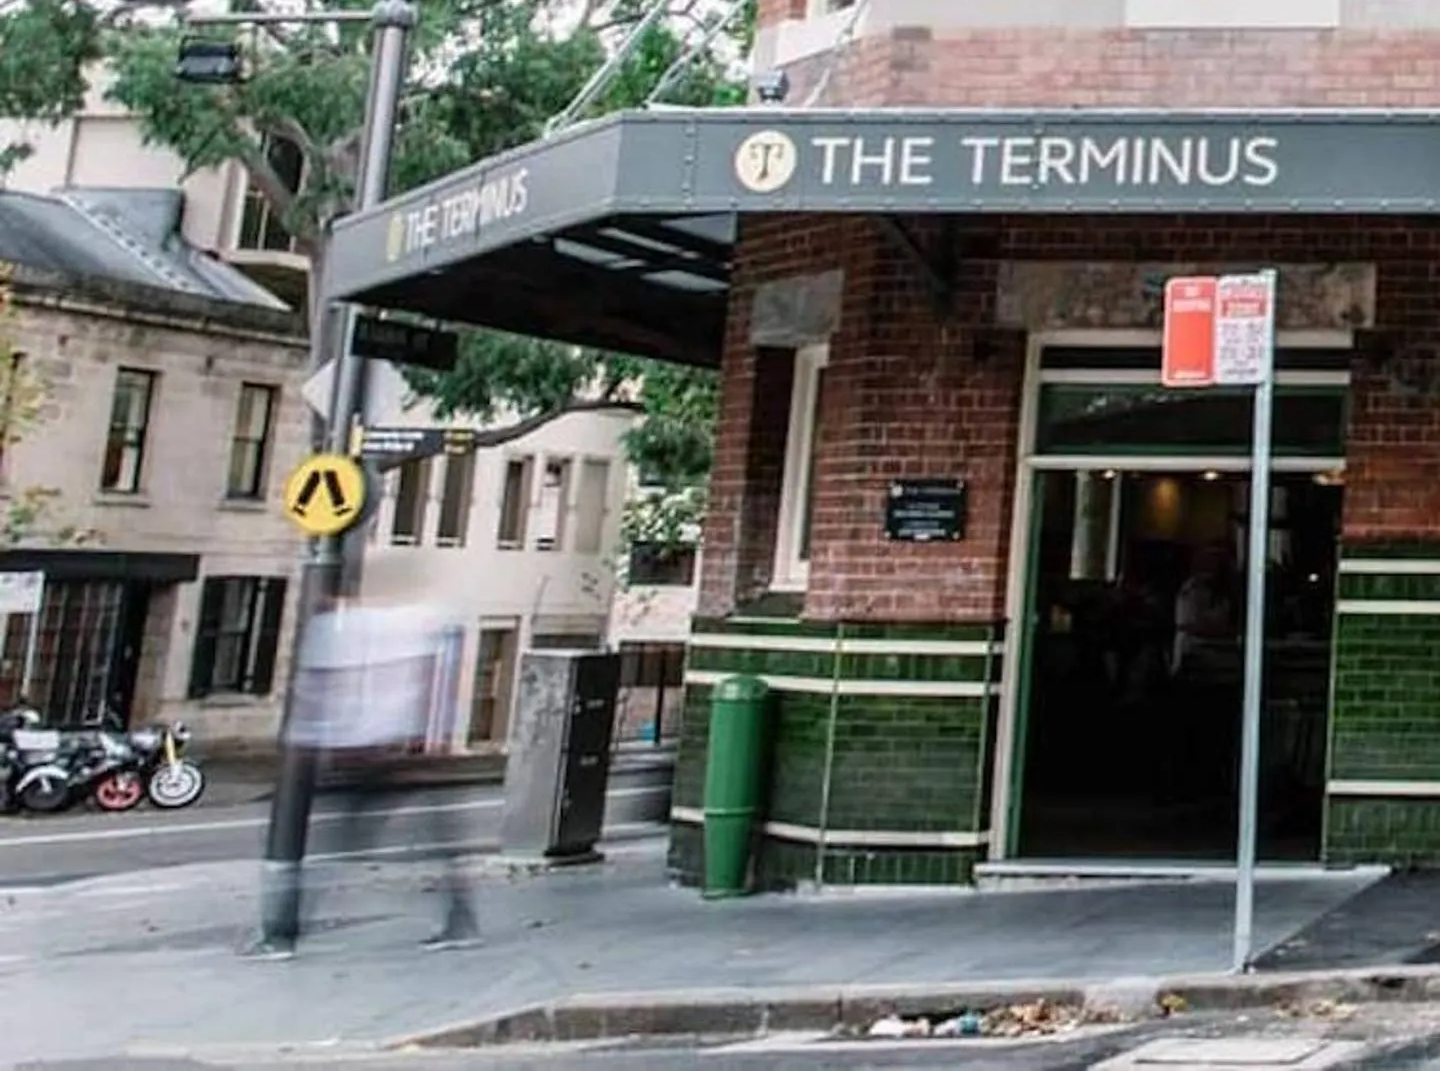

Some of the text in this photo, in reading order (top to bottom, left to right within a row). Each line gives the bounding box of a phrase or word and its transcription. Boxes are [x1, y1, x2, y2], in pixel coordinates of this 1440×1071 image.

[813, 137, 933, 186] THE
[961, 137, 1279, 187] TERMINUS
[406, 167, 528, 252] THE TERMINUS
